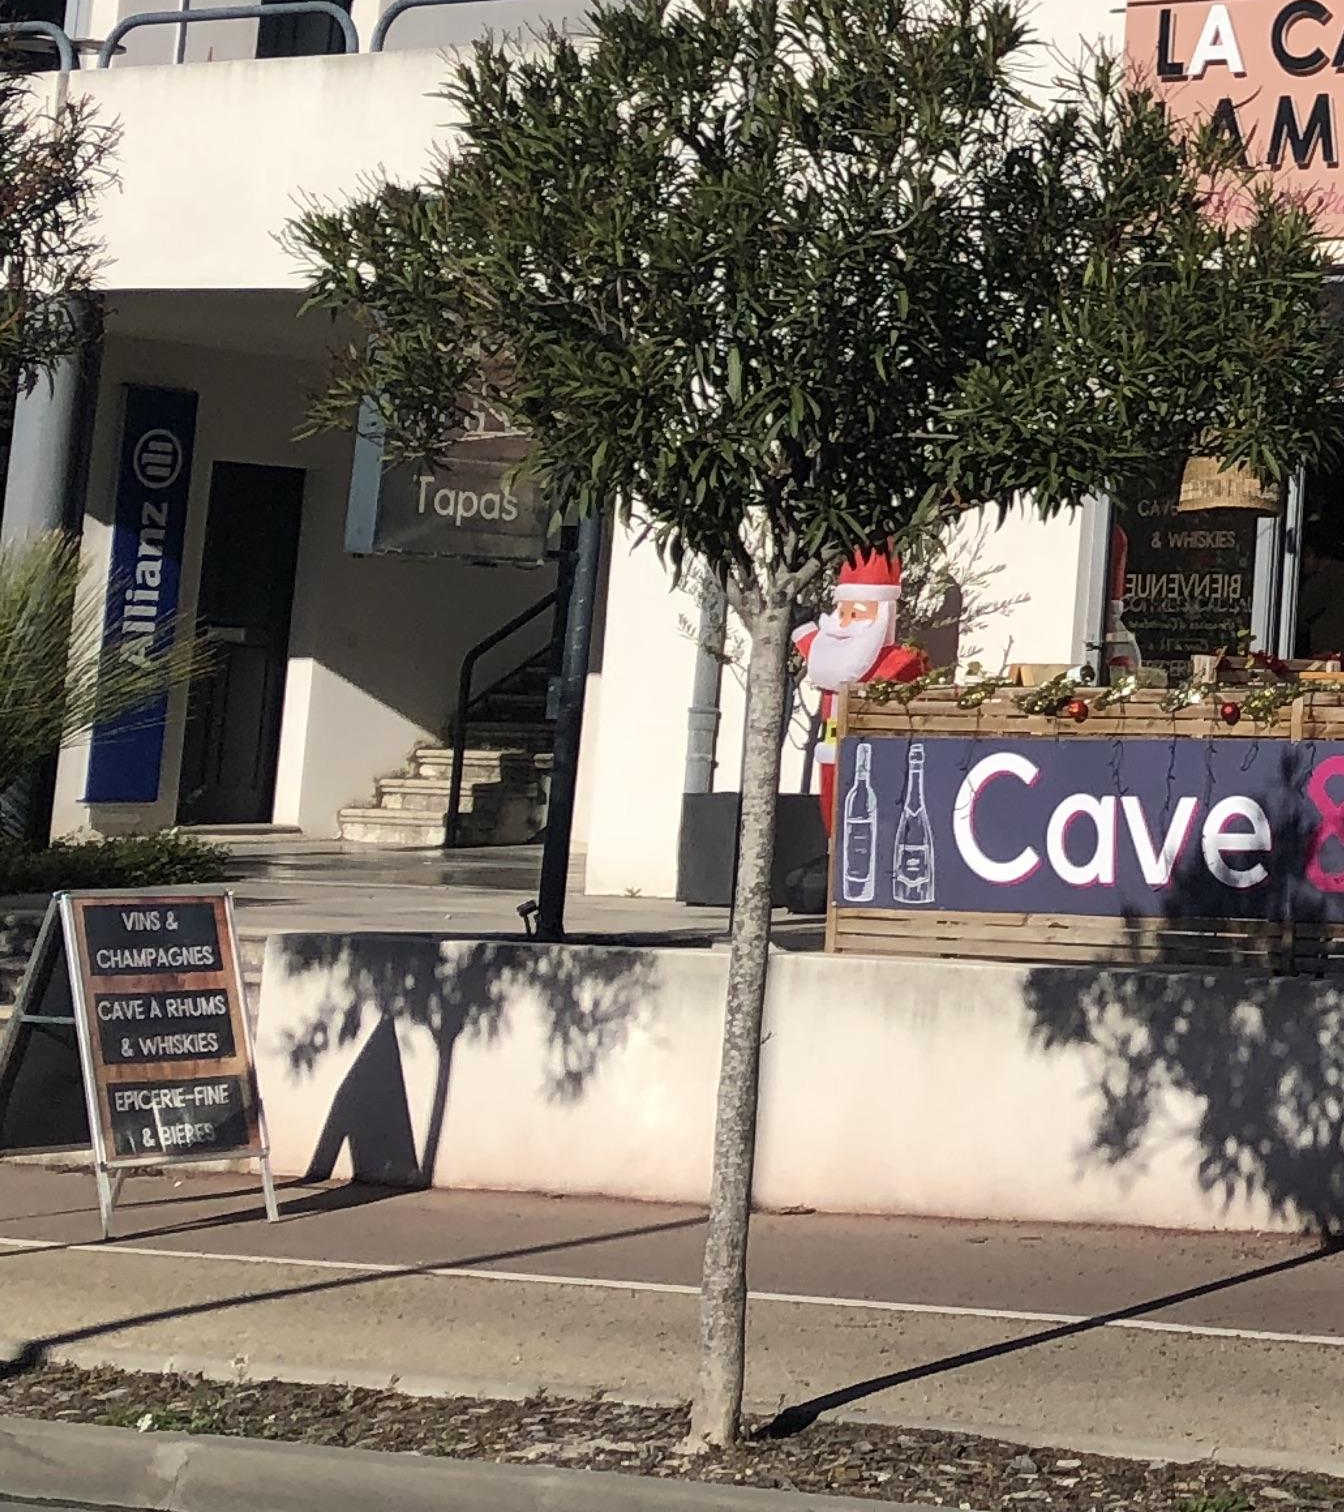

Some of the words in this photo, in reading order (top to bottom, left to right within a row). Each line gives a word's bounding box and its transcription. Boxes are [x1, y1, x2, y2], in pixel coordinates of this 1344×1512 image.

[1157, 4, 1247, 82] LA
[413, 474, 519, 527] Tapas
[1168, 530, 1236, 549] WHISKIES
[952, 751, 1273, 888] Cave
[121, 911, 161, 931] VINS
[165, 911, 178, 931] &
[96, 945, 215, 969] CHAMPAGNES
[97, 999, 145, 1021] CAVE
[165, 995, 226, 1018] RHUMS
[120, 1038, 134, 1058] &
[138, 1032, 219, 1056] WHISKIES
[142, 1127, 156, 1148] &
